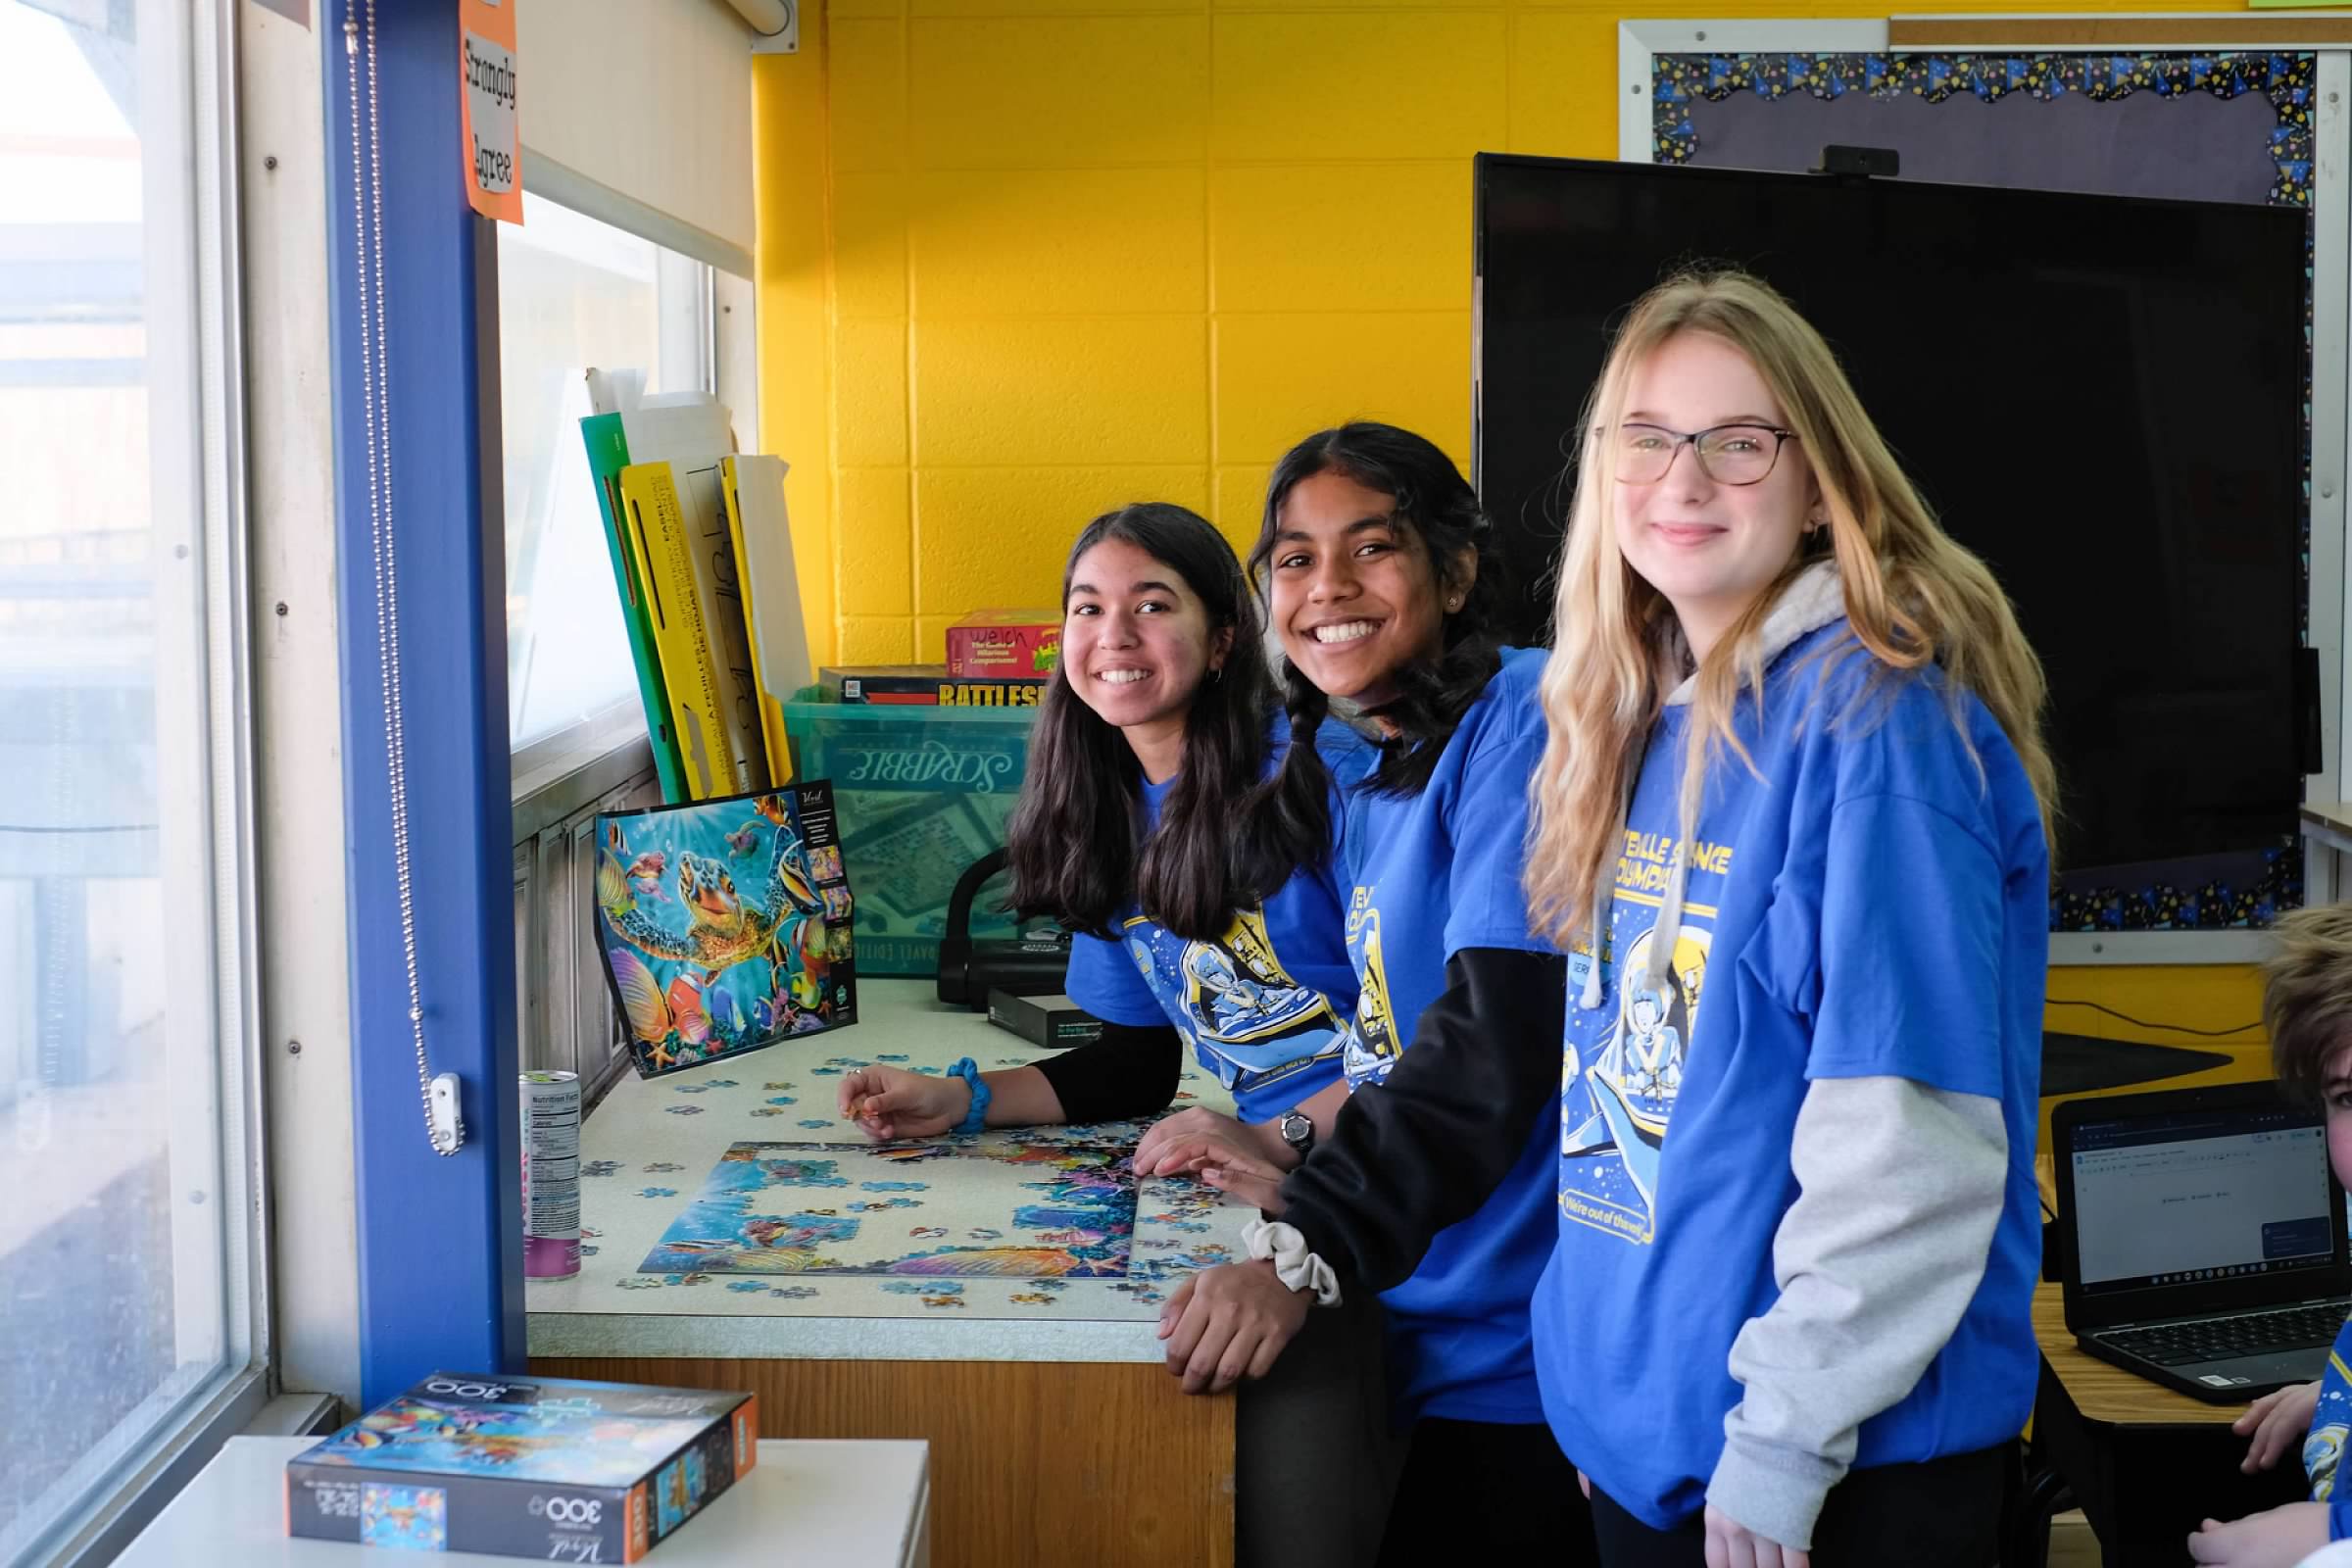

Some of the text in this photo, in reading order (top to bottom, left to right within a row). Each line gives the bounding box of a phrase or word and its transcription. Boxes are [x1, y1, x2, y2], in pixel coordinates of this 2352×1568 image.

[849, 740, 1012, 794] SCRABBLE
[426, 1380, 507, 1403] 300
[546, 1496, 603, 1525] 300
